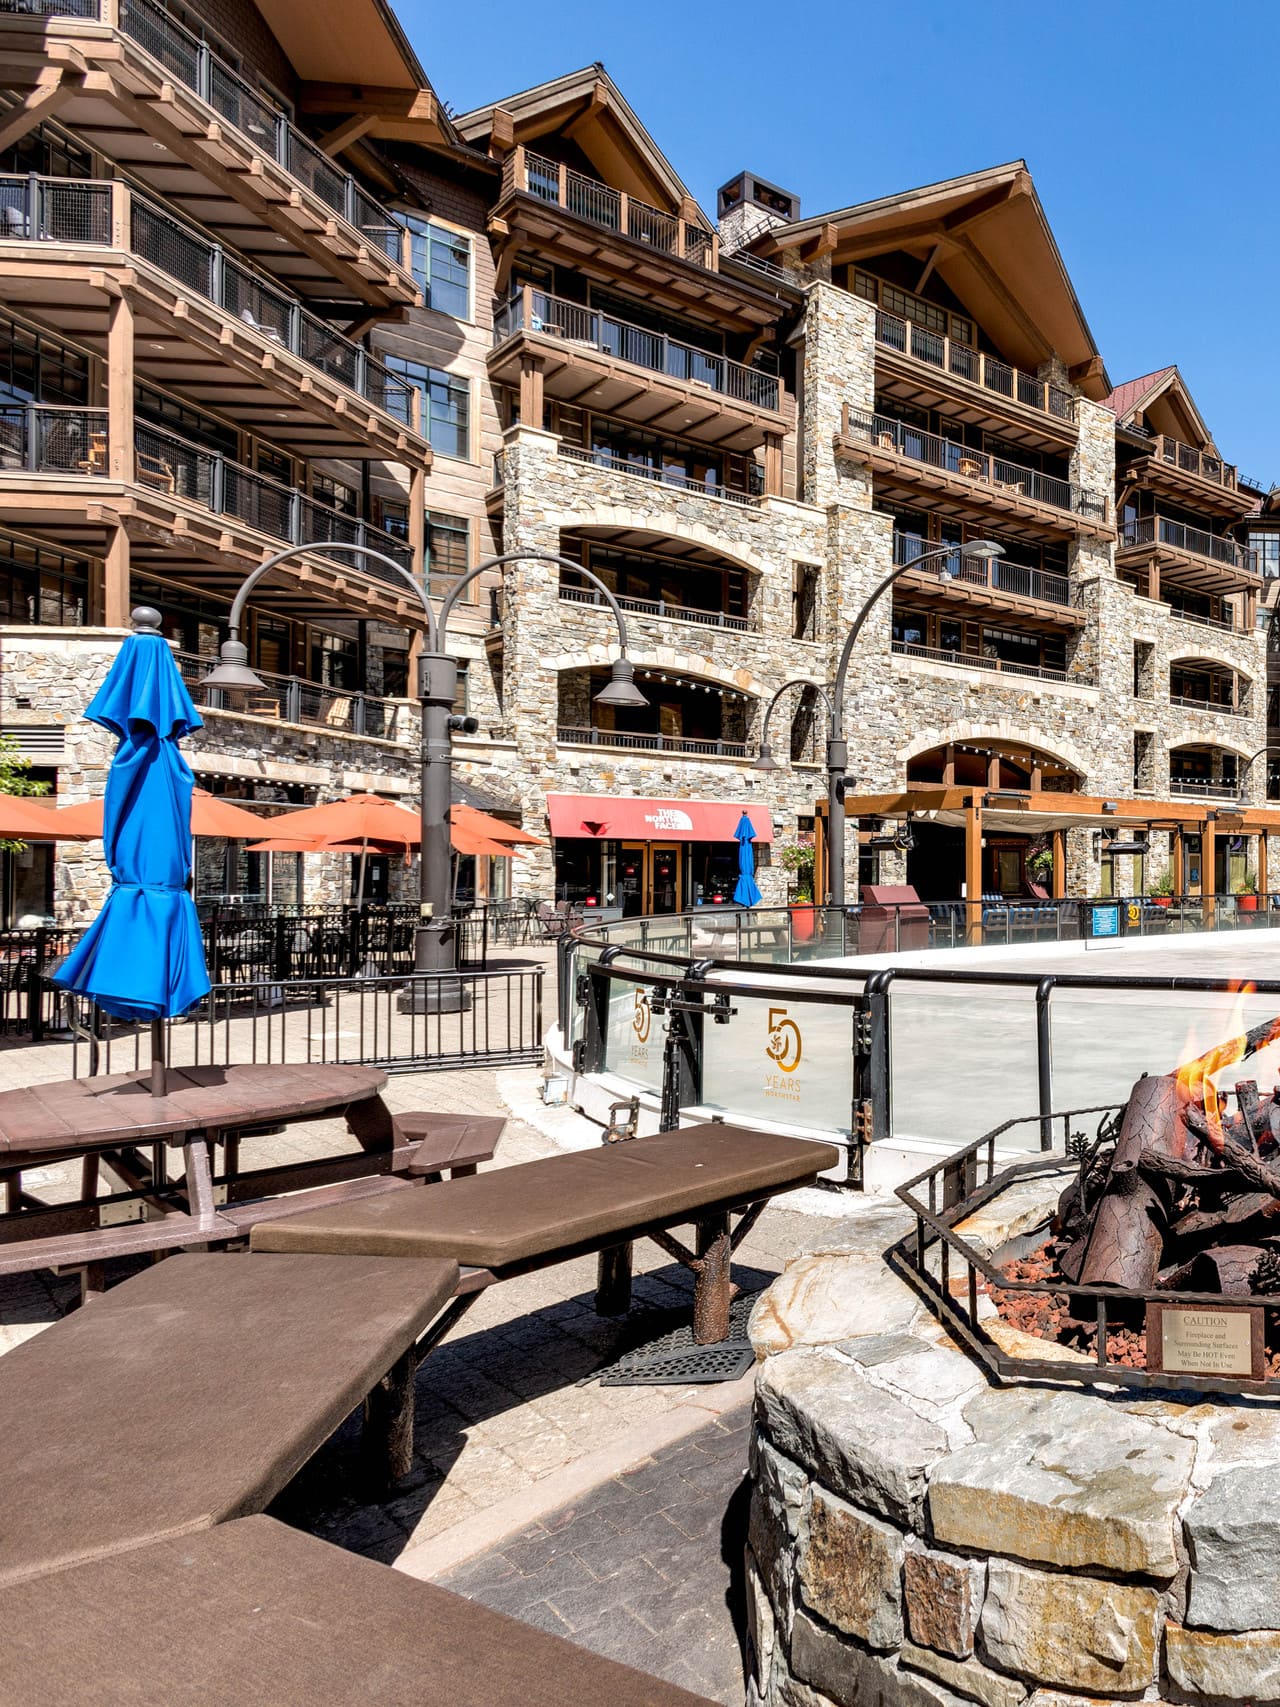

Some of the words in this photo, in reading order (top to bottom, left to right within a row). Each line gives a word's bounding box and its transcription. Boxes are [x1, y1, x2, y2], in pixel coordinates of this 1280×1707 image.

[644, 815, 677, 823] NORTH
[766, 1008, 802, 1073] 50
[765, 1073, 801, 1092] YEARS
[1183, 1315, 1228, 1326] CAUTION
[1186, 1331, 1213, 1339] Fireplace
[1213, 1341, 1238, 1349] Surfaces
[1177, 1350, 1191, 1358] May
[1193, 1350, 1201, 1358] Be
[1203, 1351, 1218, 1359] HOT
[1181, 1359, 1198, 1367] When
